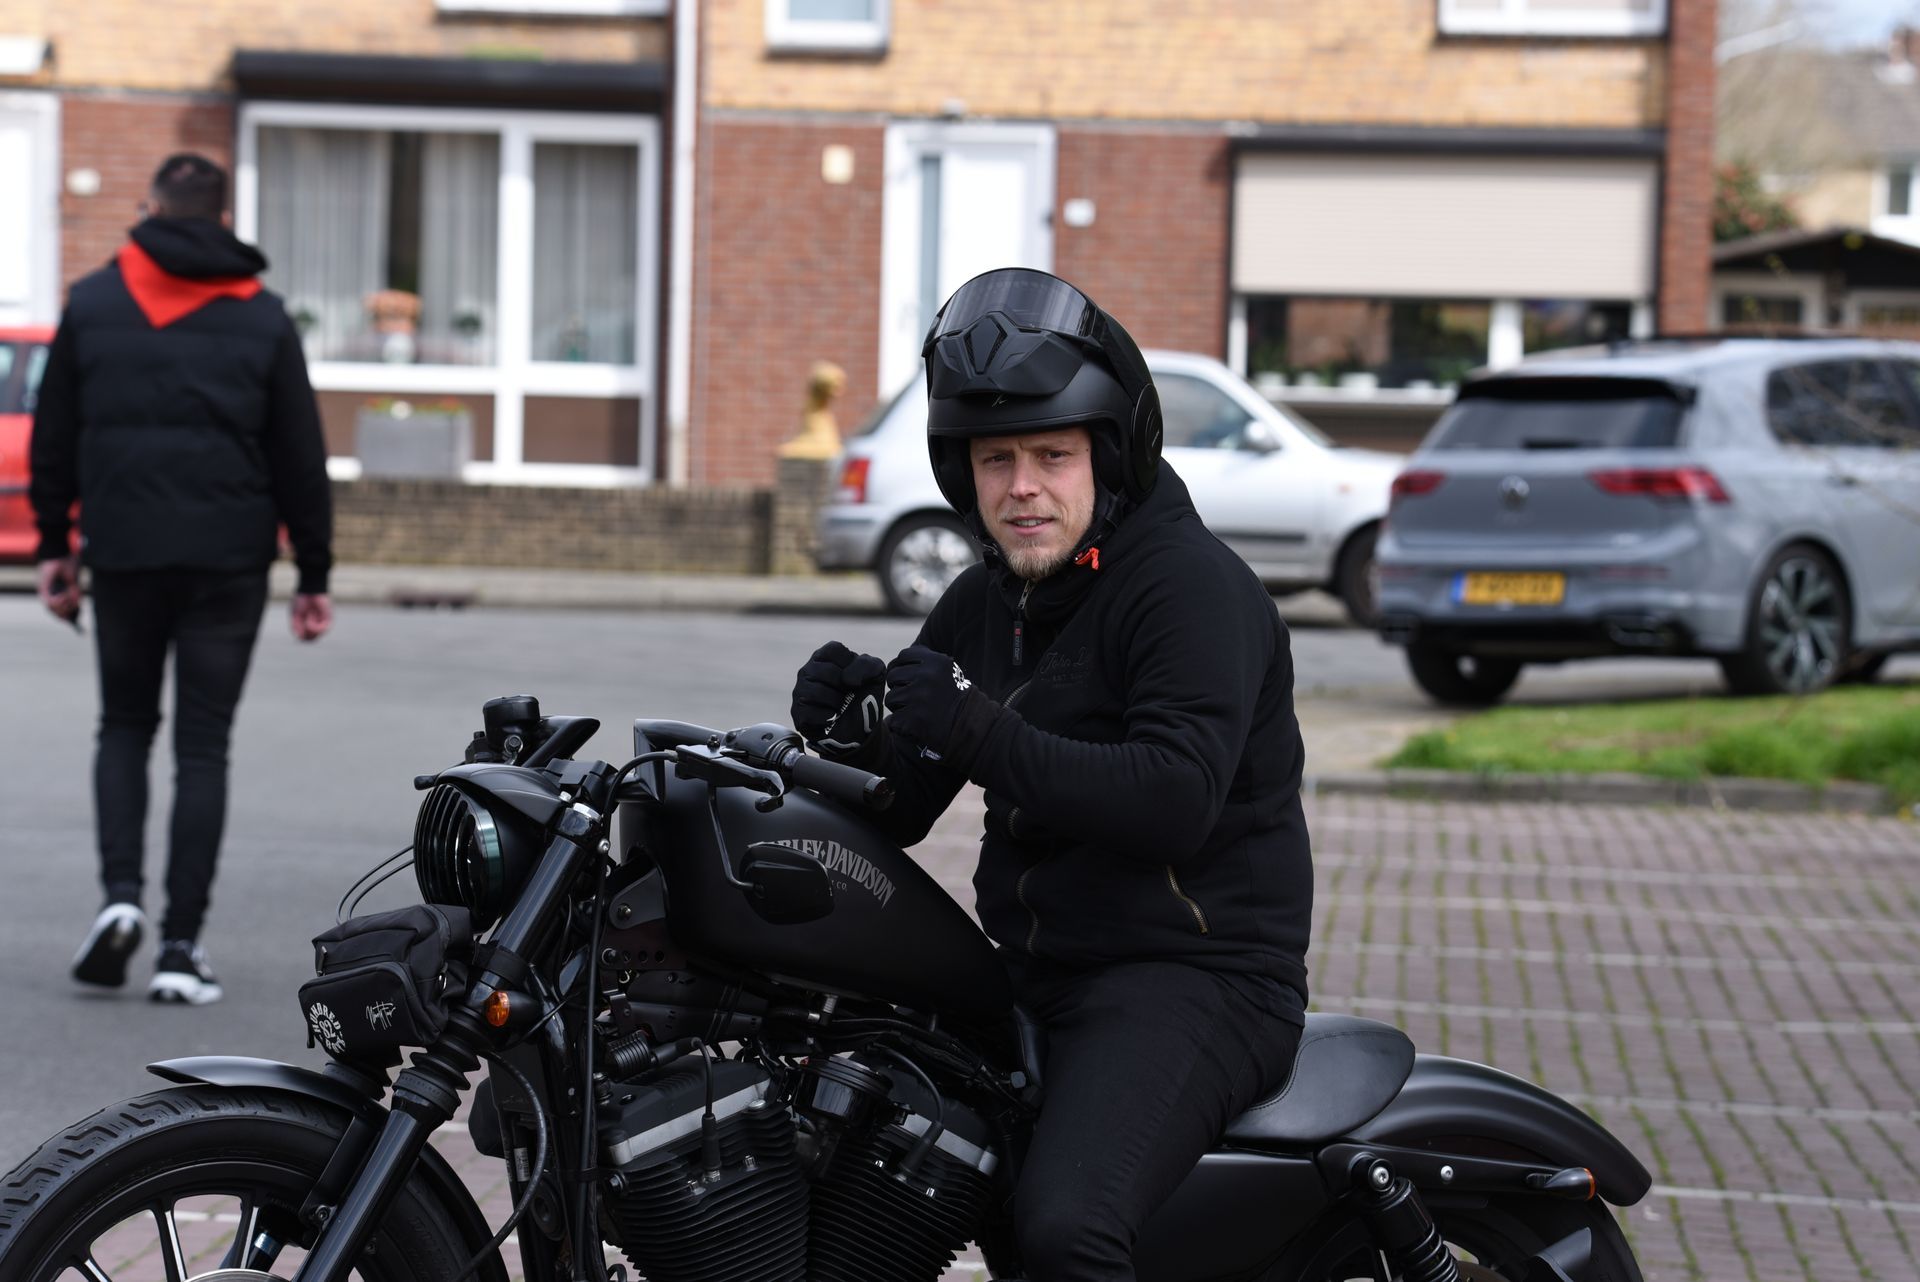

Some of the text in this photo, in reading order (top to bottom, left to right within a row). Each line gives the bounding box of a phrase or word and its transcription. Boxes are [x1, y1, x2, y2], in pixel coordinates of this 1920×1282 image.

[824, 840, 896, 909] DAVIDSON
[309, 1002, 341, 1033] HUNDRED
[318, 1019, 336, 1039] 82
